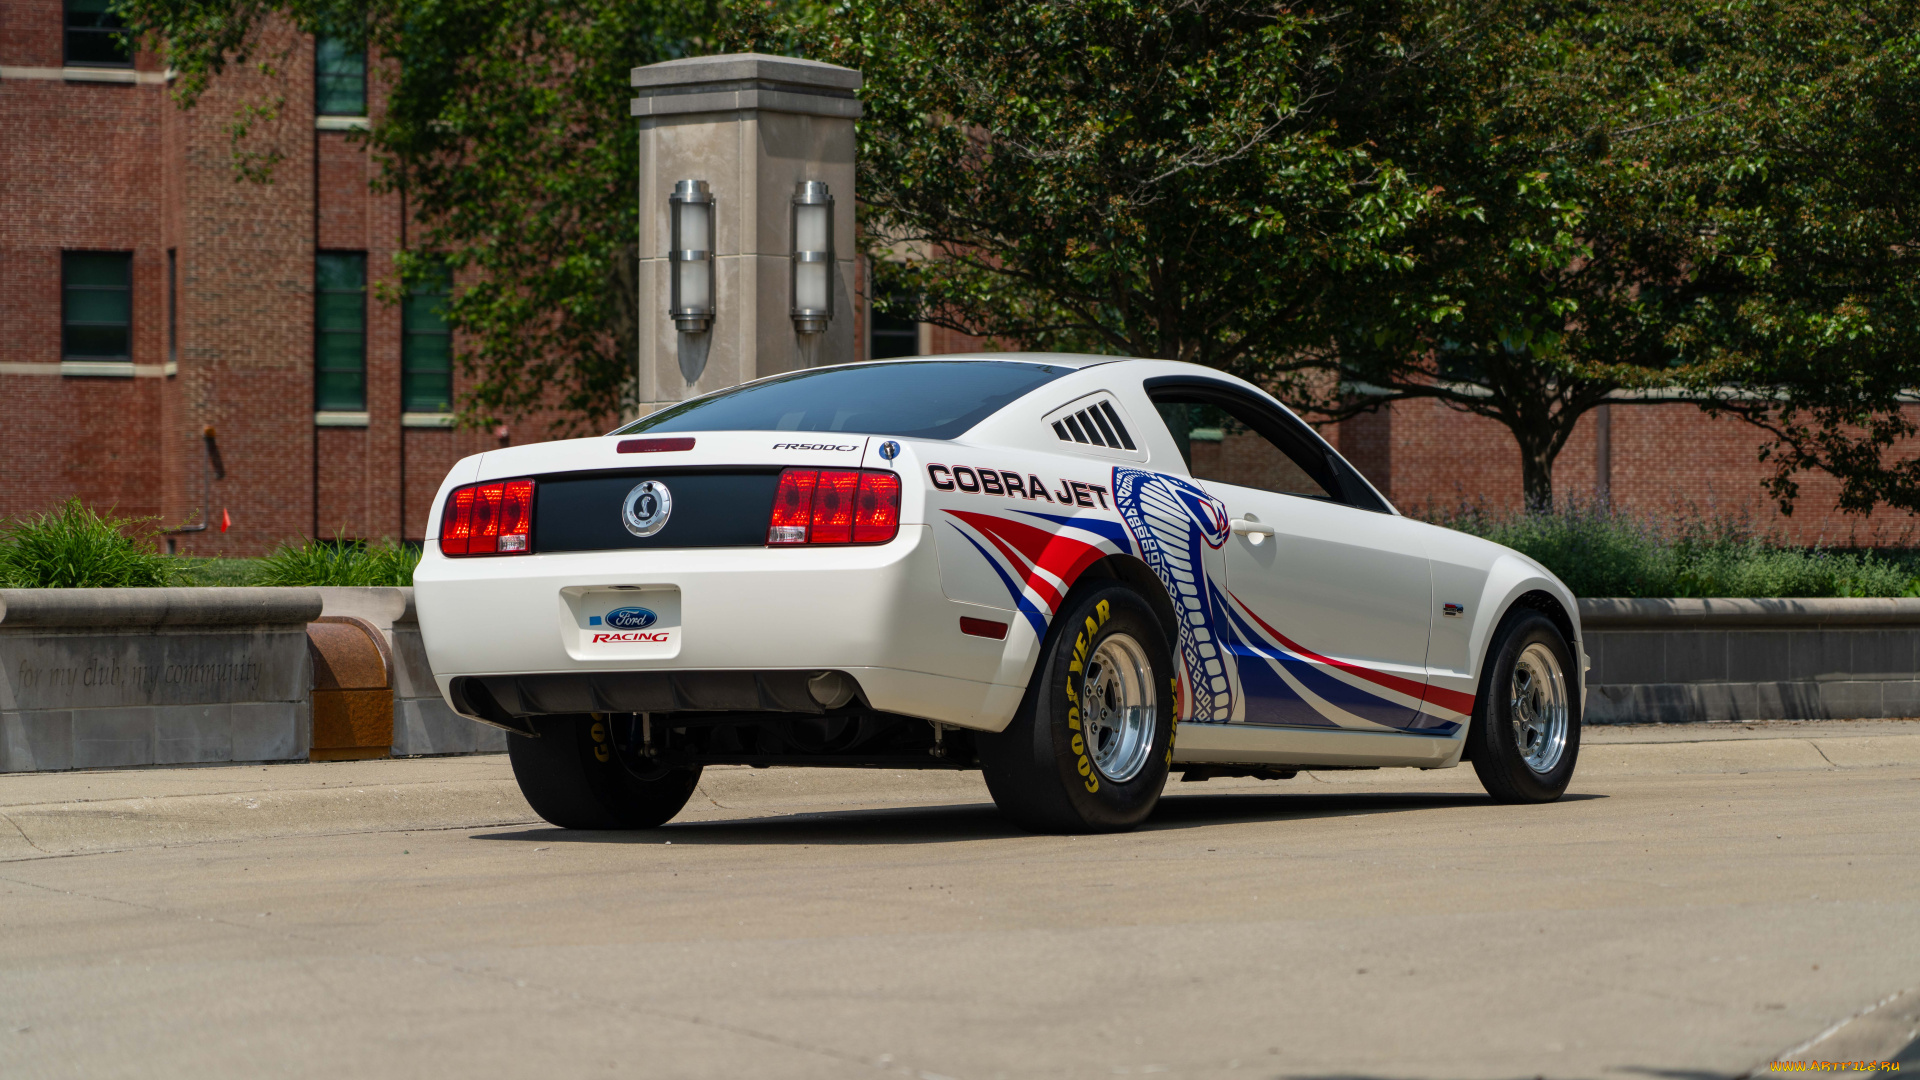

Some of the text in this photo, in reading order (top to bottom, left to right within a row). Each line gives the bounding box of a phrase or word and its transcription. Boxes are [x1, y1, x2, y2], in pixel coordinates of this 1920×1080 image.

[772, 443, 859, 452] FR500CJ
[926, 462, 1110, 511] COBRA JET
[615, 610, 648, 626] Ford
[592, 632, 670, 643] RACING
[14, 654, 262, 698] for my club, my community
[1066, 599, 1111, 793] GOODYEAR
